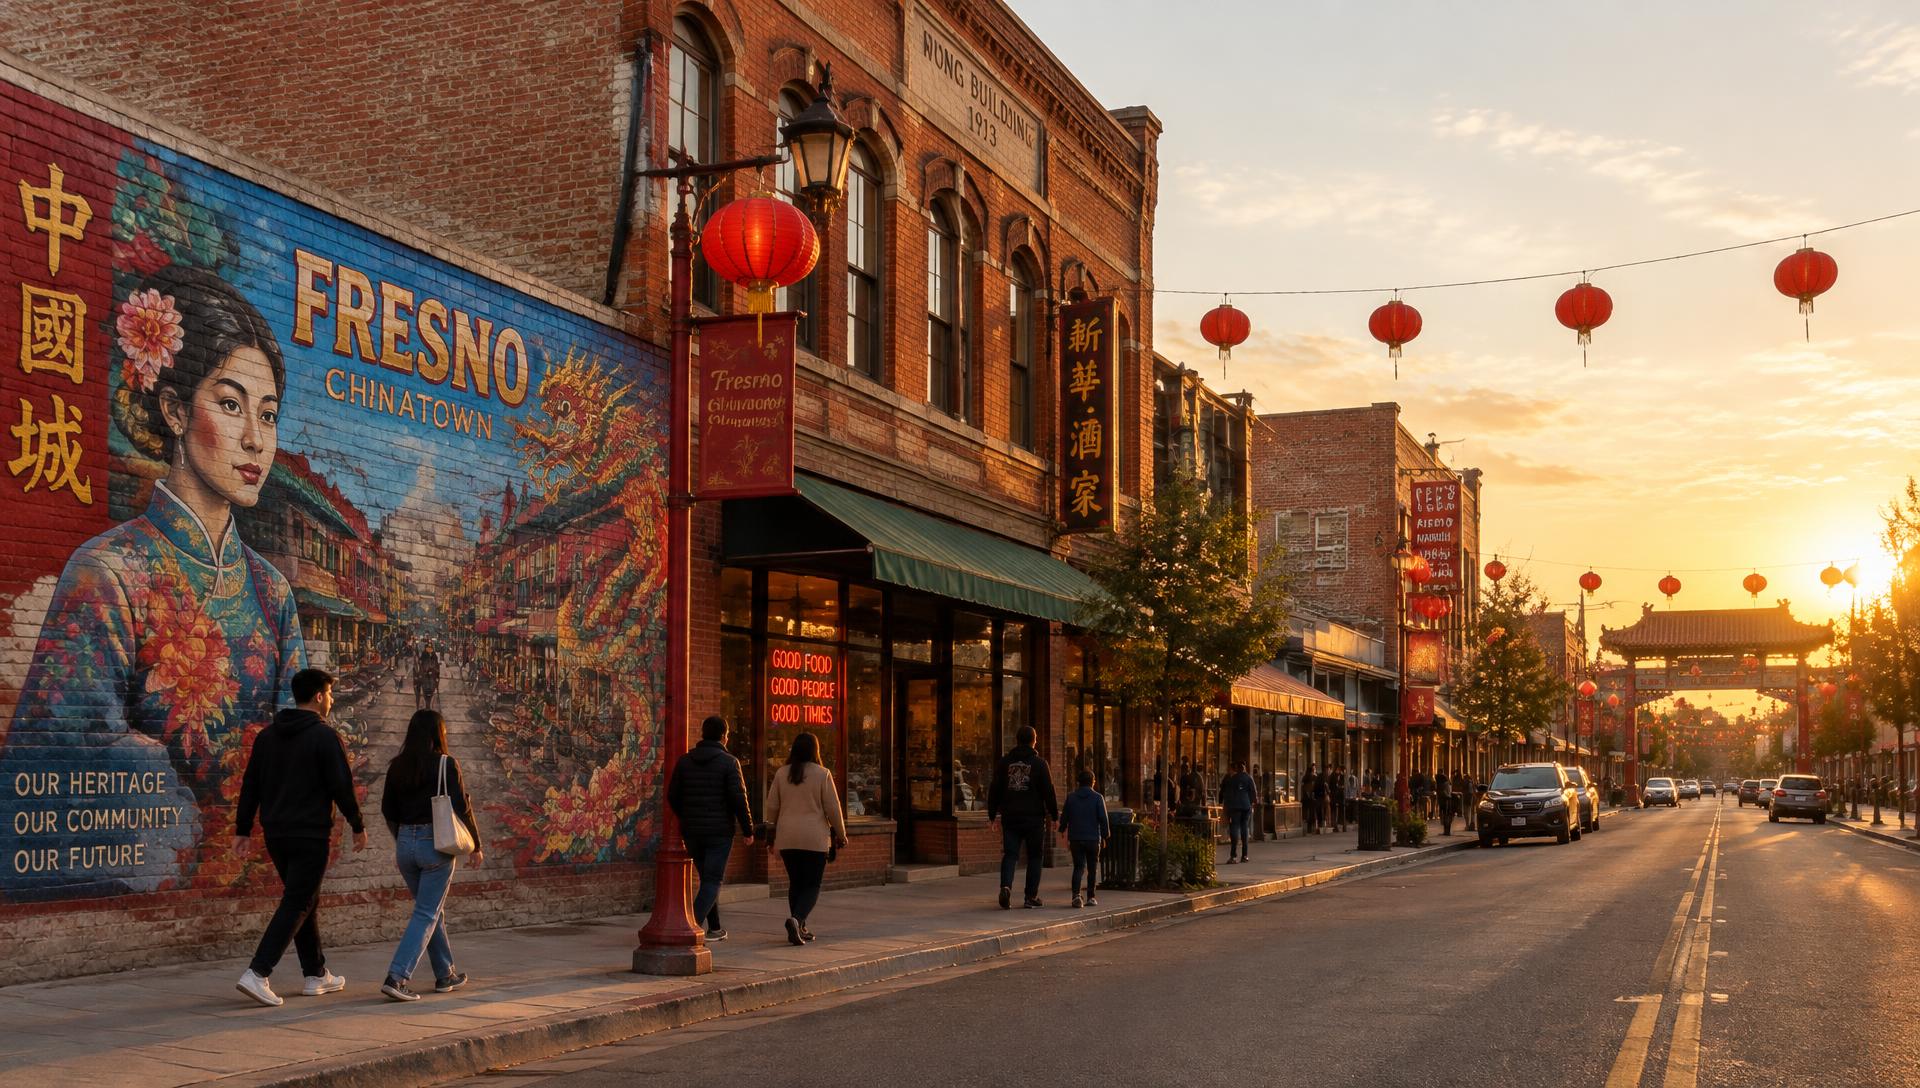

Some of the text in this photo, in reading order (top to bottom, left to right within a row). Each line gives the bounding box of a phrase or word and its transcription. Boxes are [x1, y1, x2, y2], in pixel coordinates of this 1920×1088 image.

[968, 106, 998, 147] 1913
[7, 162, 94, 505] 中國城
[291, 247, 531, 408] FRESNO
[325, 367, 493, 440] CHINATOWN
[772, 649, 833, 674] GOOD FOOD
[771, 677, 835, 699] GOOD PEOPLE
[771, 704, 800, 722] GOOD
[14, 772, 166, 797] OUR HERITAGE
[14, 807, 183, 835] OUR COMMUNITY
[14, 845, 145, 874] OUR FUTURE
